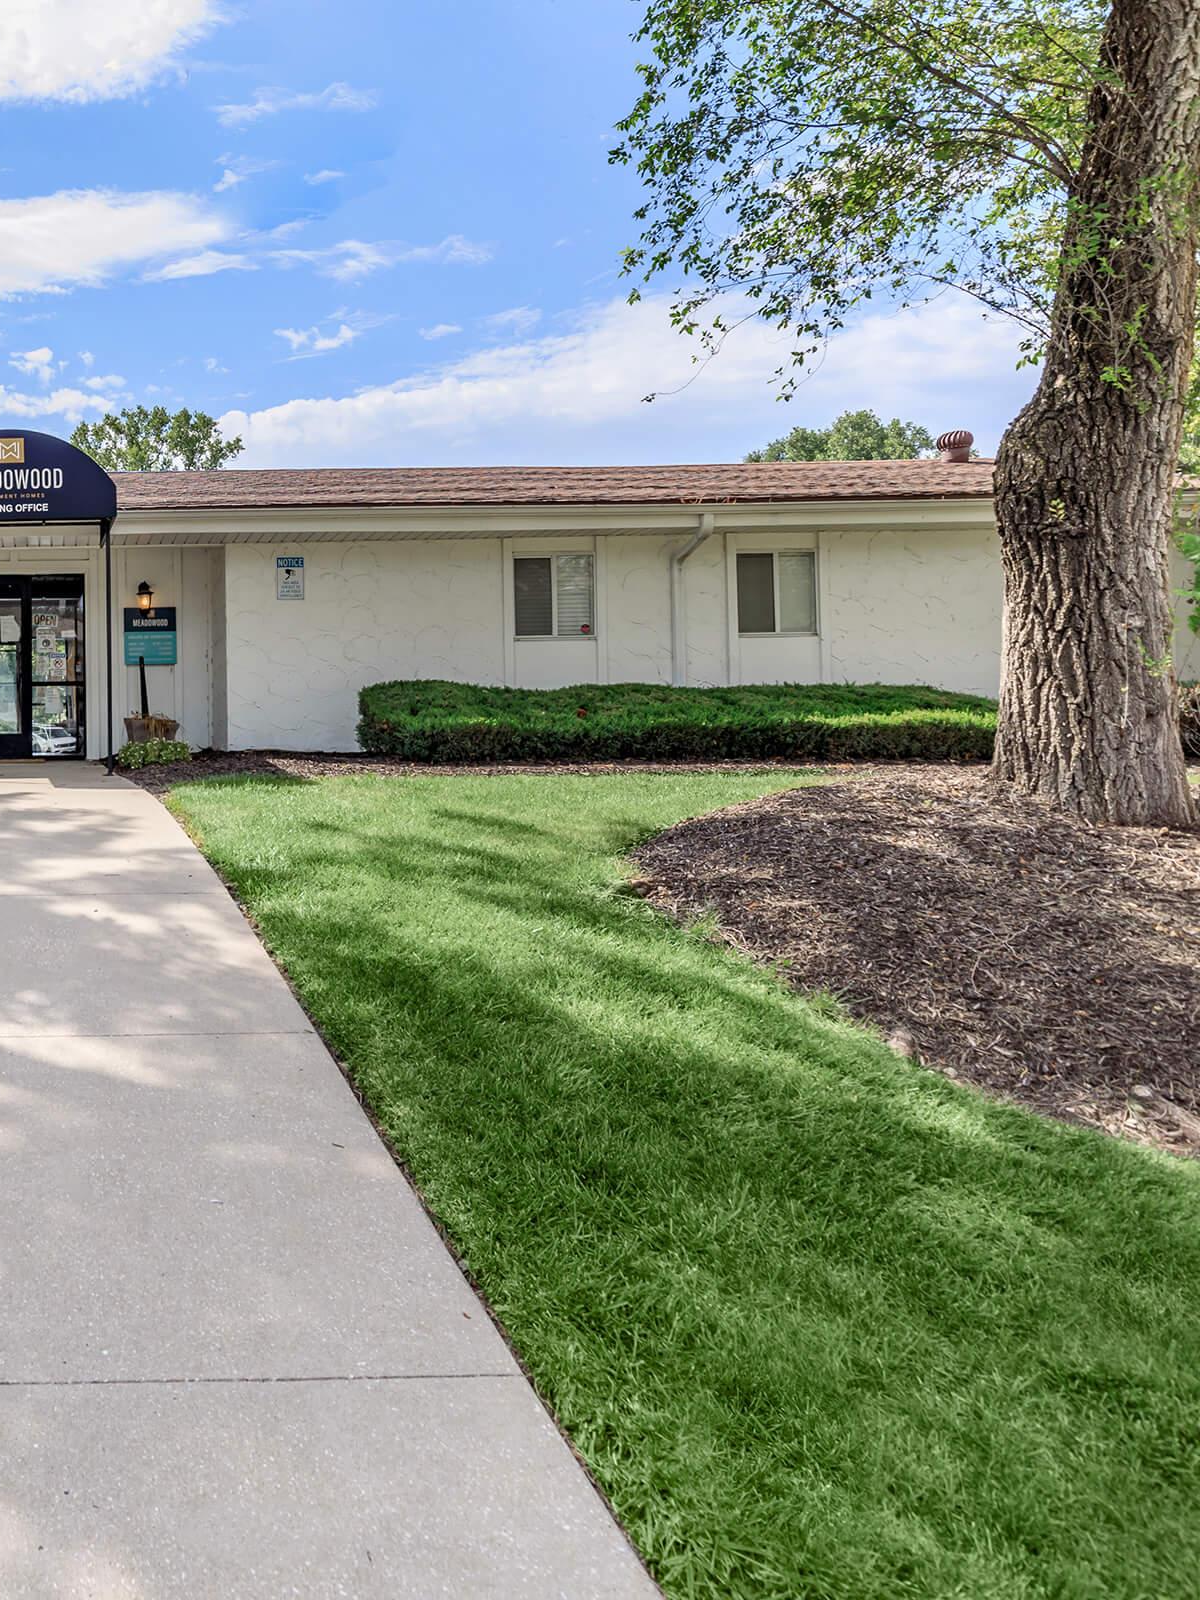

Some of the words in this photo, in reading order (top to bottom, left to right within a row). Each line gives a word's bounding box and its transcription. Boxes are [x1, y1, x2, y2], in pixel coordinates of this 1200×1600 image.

[15, 503, 49, 512] OFFICE
[278, 559, 304, 567] NOTICE
[33, 614, 57, 626] OPEN
